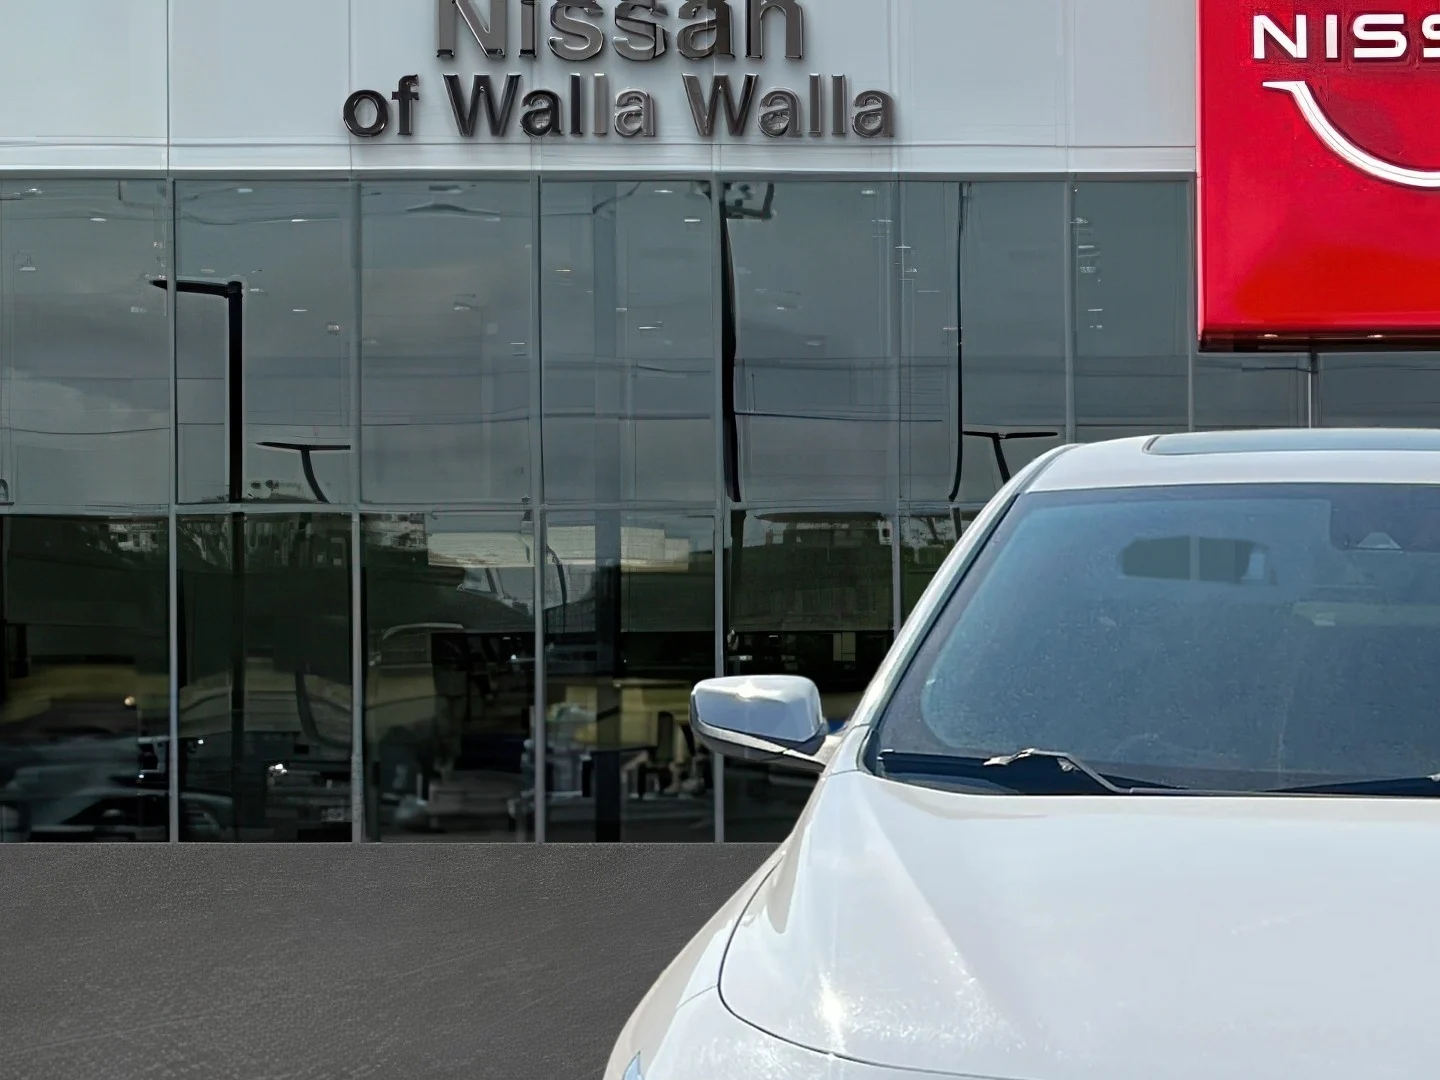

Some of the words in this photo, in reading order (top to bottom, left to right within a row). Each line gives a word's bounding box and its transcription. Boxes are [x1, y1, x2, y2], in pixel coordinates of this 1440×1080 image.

[436, 0, 804, 61] Nissan
[343, 74, 420, 137] of
[442, 73, 655, 137] Walla
[681, 73, 894, 137] Walla
